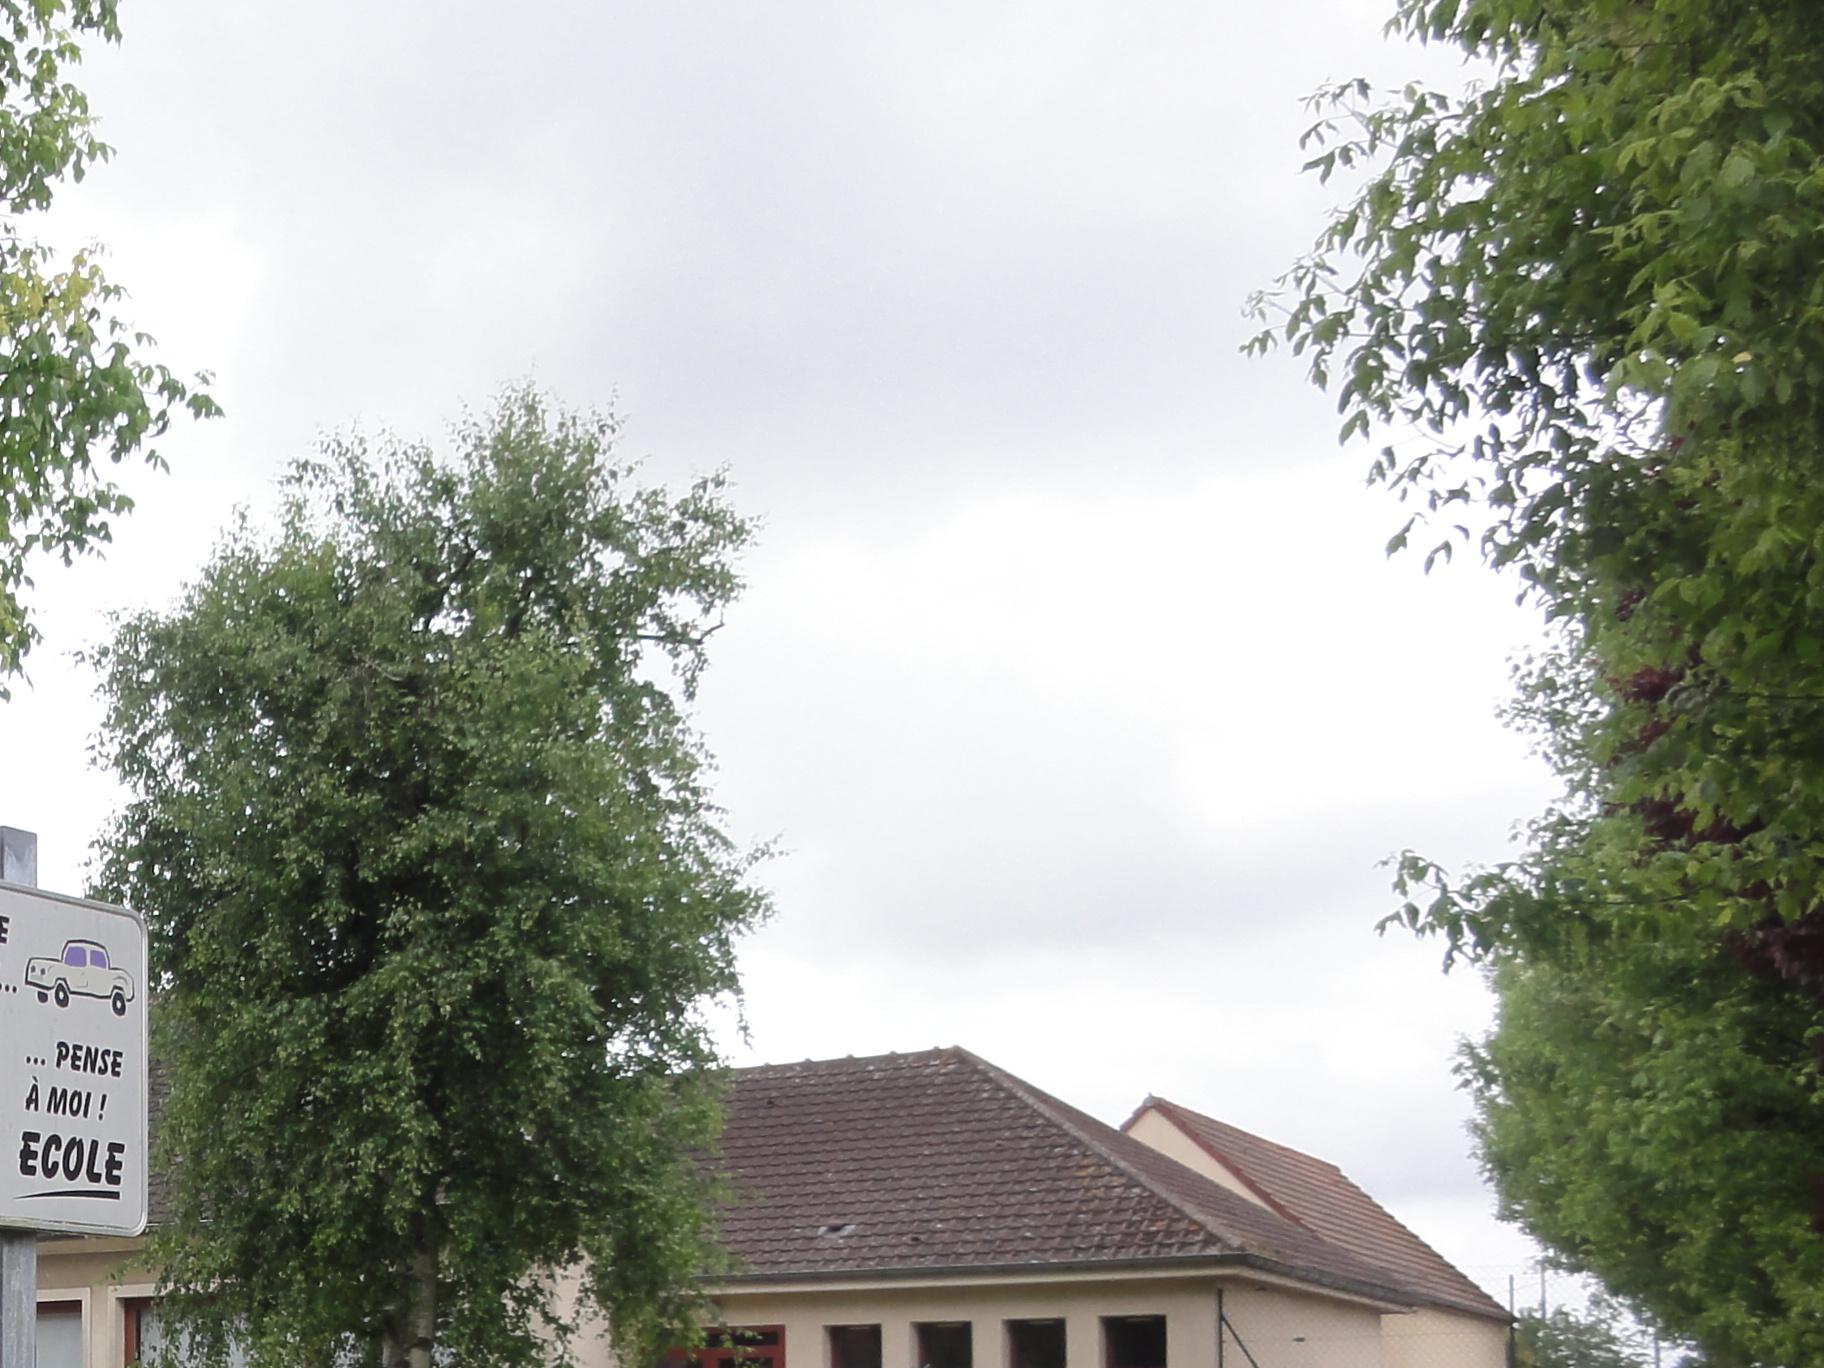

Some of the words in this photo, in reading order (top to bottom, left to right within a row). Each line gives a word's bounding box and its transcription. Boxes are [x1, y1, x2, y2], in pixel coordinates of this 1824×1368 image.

[55, 1041, 124, 1078] PENSE
[25, 1076, 39, 1112] À
[46, 1086, 92, 1119] MOI
[19, 1131, 126, 1187] ECOLE
